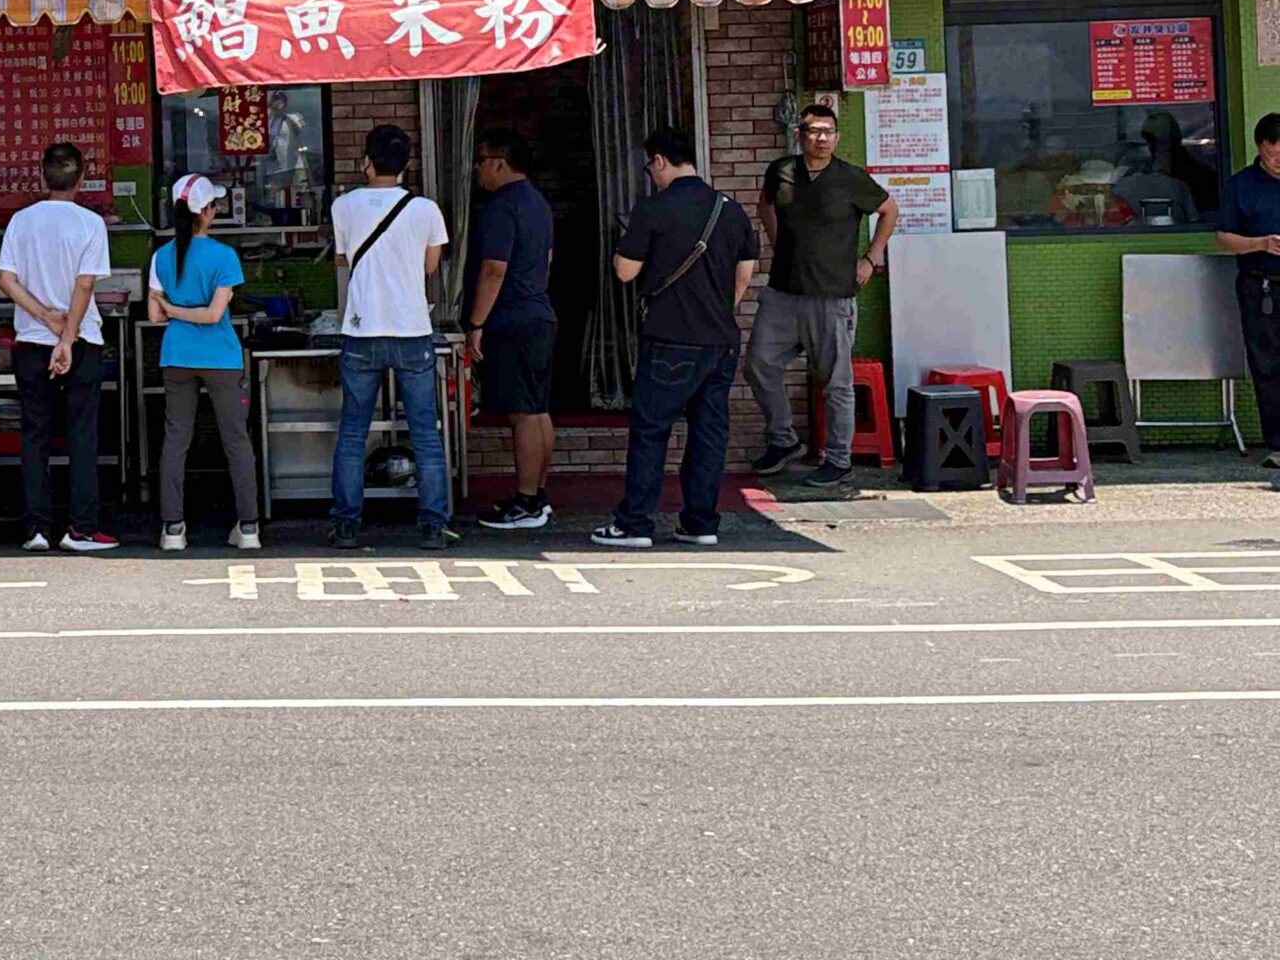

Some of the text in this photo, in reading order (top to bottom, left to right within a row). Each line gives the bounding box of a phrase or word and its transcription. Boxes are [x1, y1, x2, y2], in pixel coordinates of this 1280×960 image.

[847, 25, 884, 48] 19:00
[112, 40, 145, 64] 11:00
[895, 51, 917, 70] 59
[855, 67, 878, 81] 公休
[113, 81, 146, 106] 19:00
